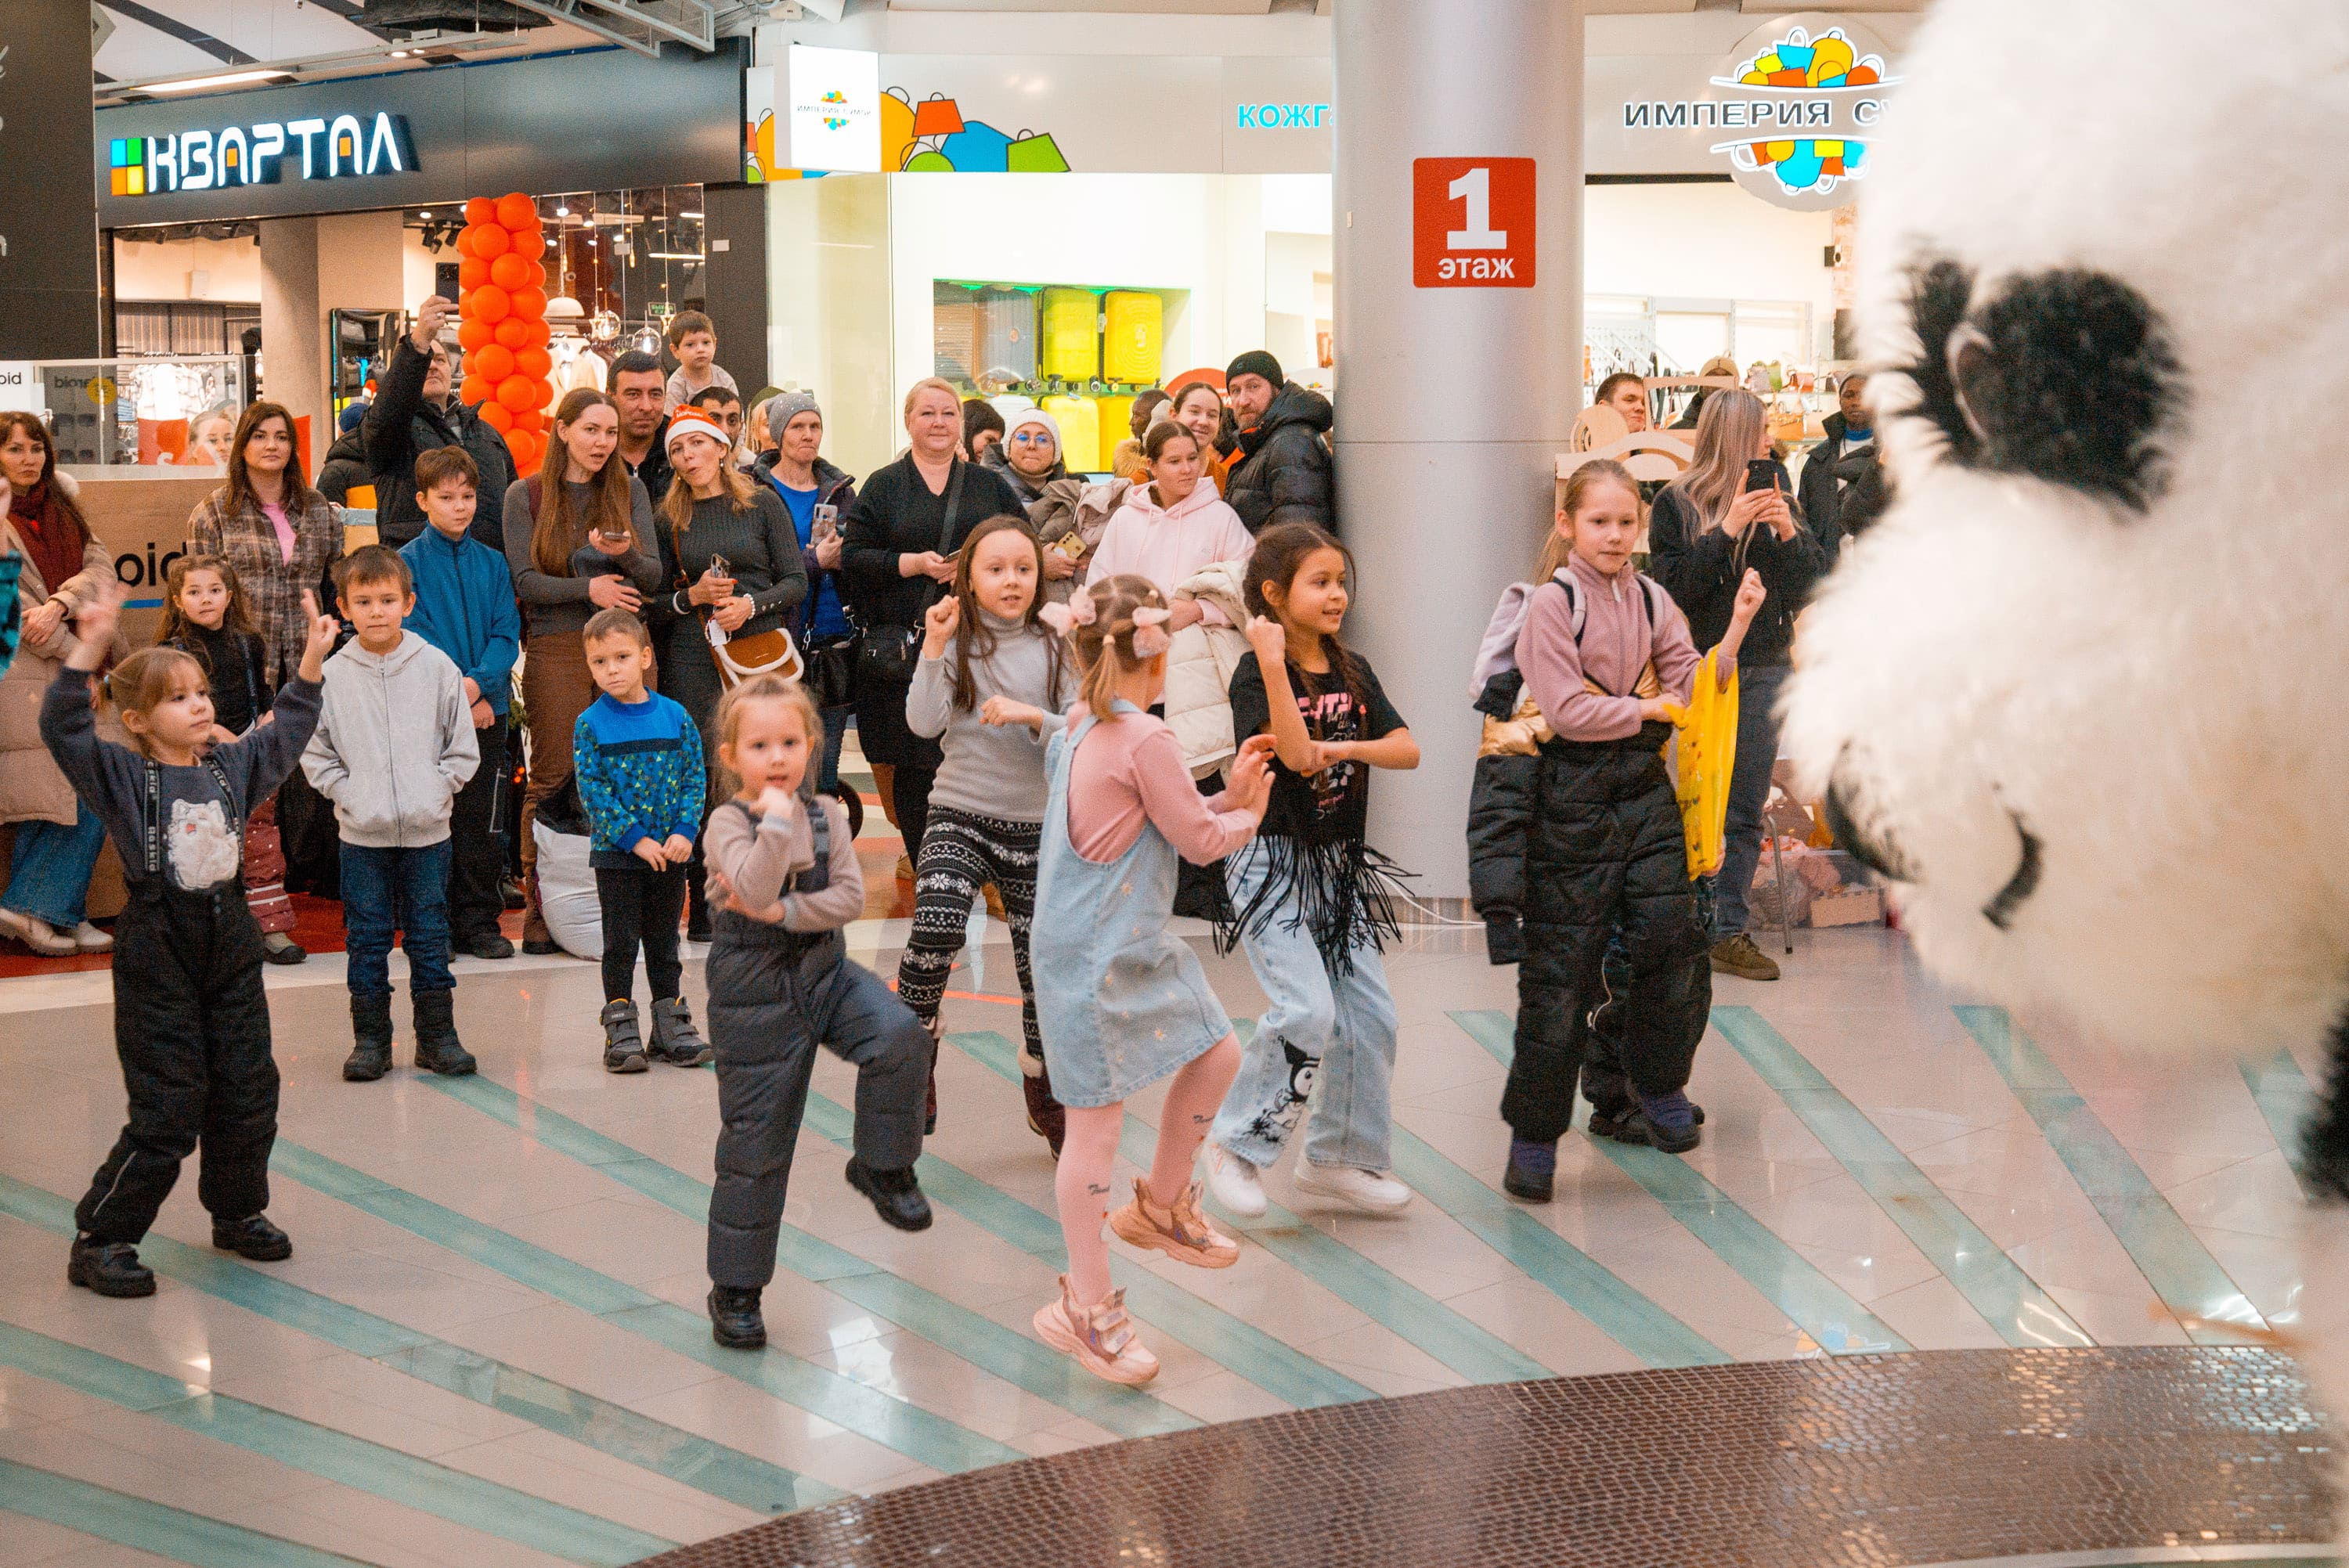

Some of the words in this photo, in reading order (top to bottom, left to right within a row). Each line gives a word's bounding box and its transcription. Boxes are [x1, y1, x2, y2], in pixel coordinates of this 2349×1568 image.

[1238, 103, 1333, 129] кожг
[1624, 99, 1833, 128] ИМПЕРИЯ
[147, 112, 402, 193] КВАРТАЛ
[1447, 167, 1507, 250] 1
[1438, 258, 1515, 279] этаж
